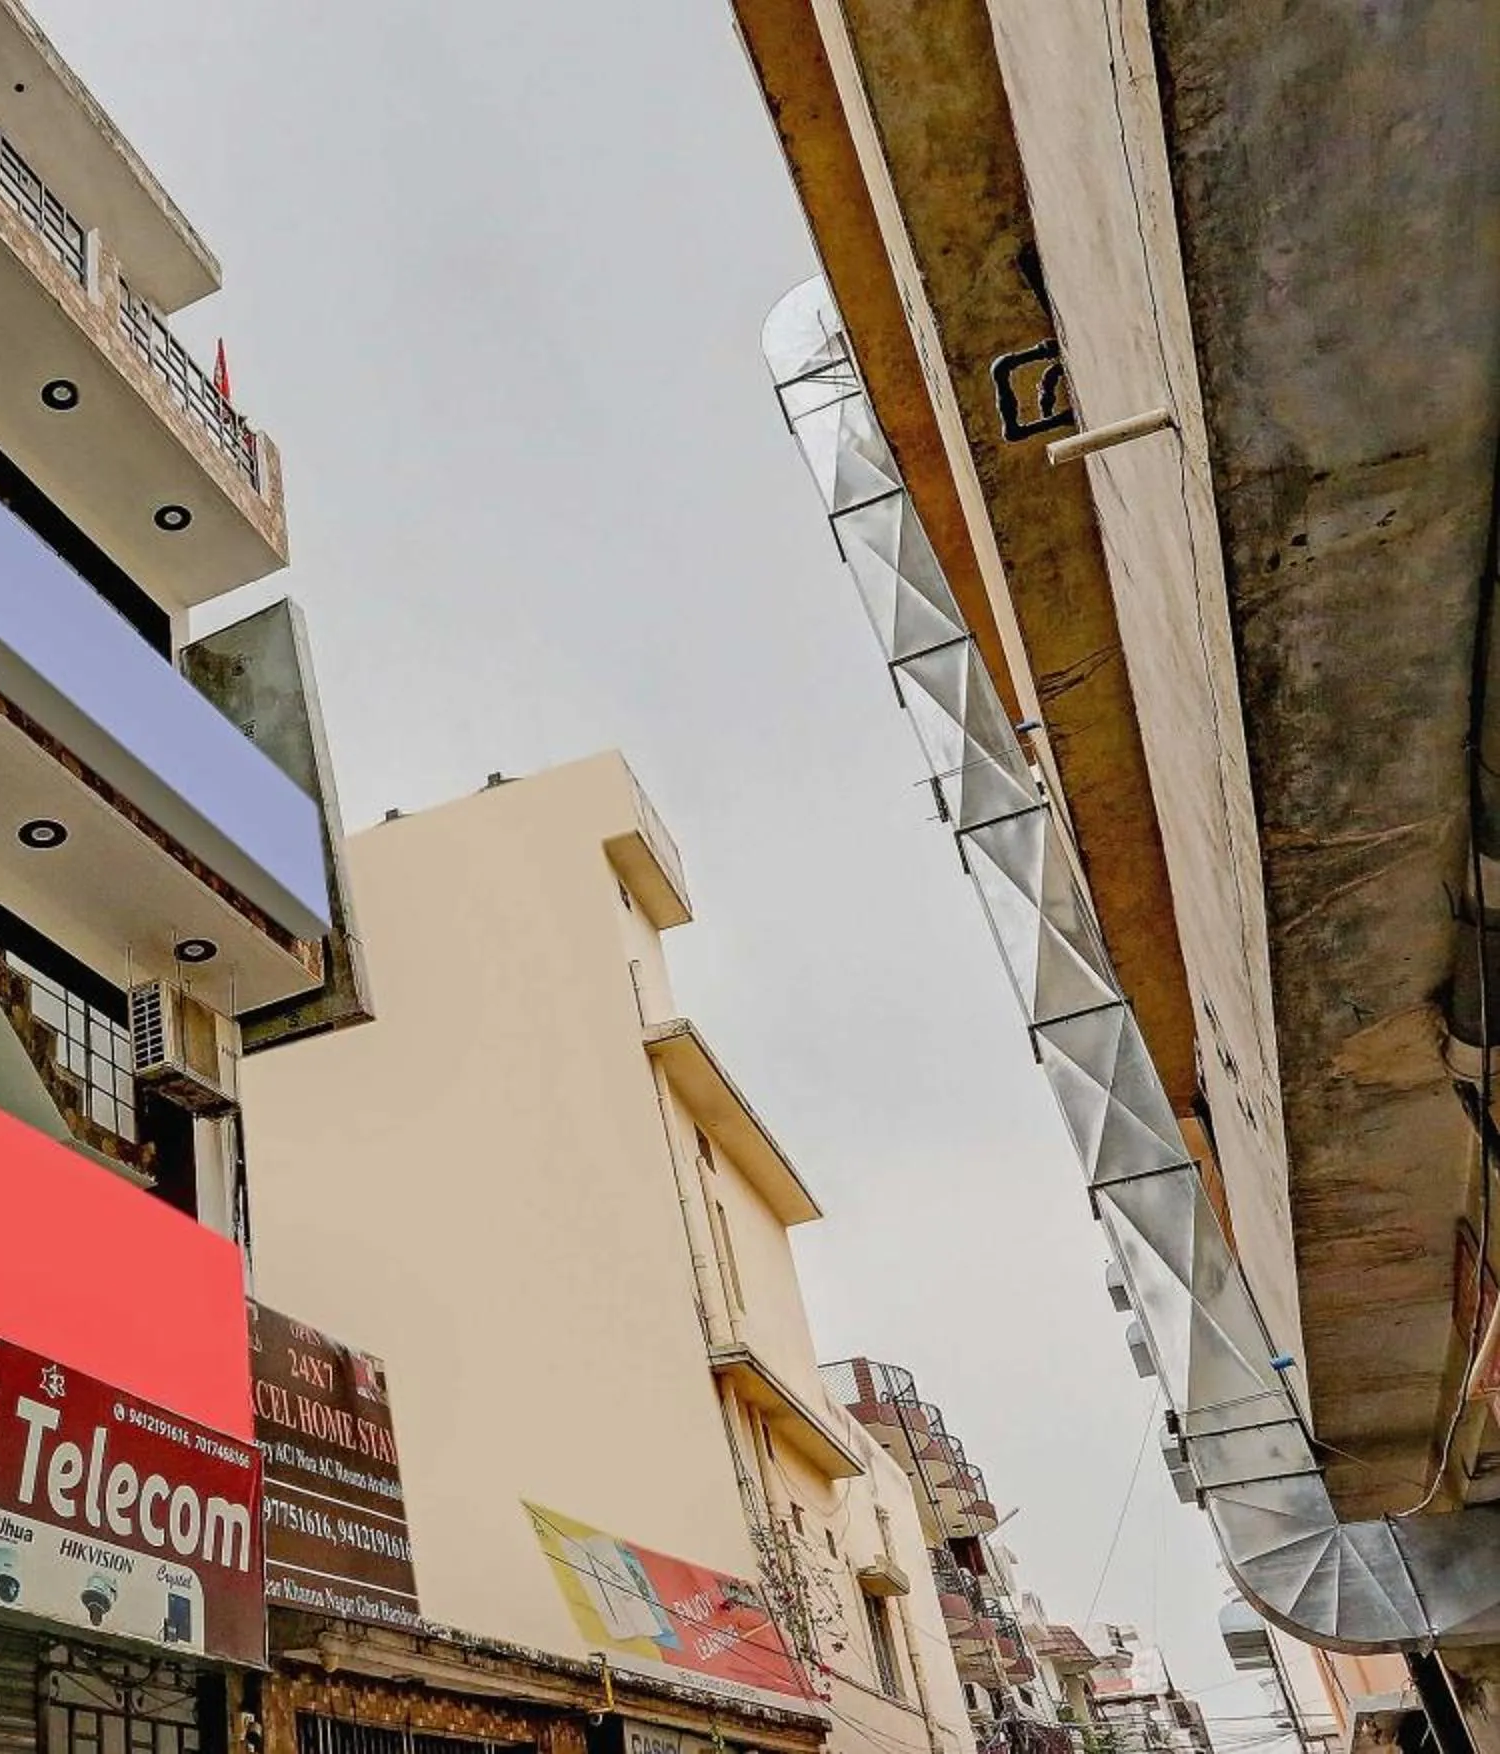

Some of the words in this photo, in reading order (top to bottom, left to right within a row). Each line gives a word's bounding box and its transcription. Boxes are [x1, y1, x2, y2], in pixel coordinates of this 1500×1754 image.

[287, 1347, 334, 1393] 24X7
[296, 1393, 357, 1451] HOME
[16, 1395, 252, 1574] Telecom
[59, 1537, 135, 1574] HIKVISION
